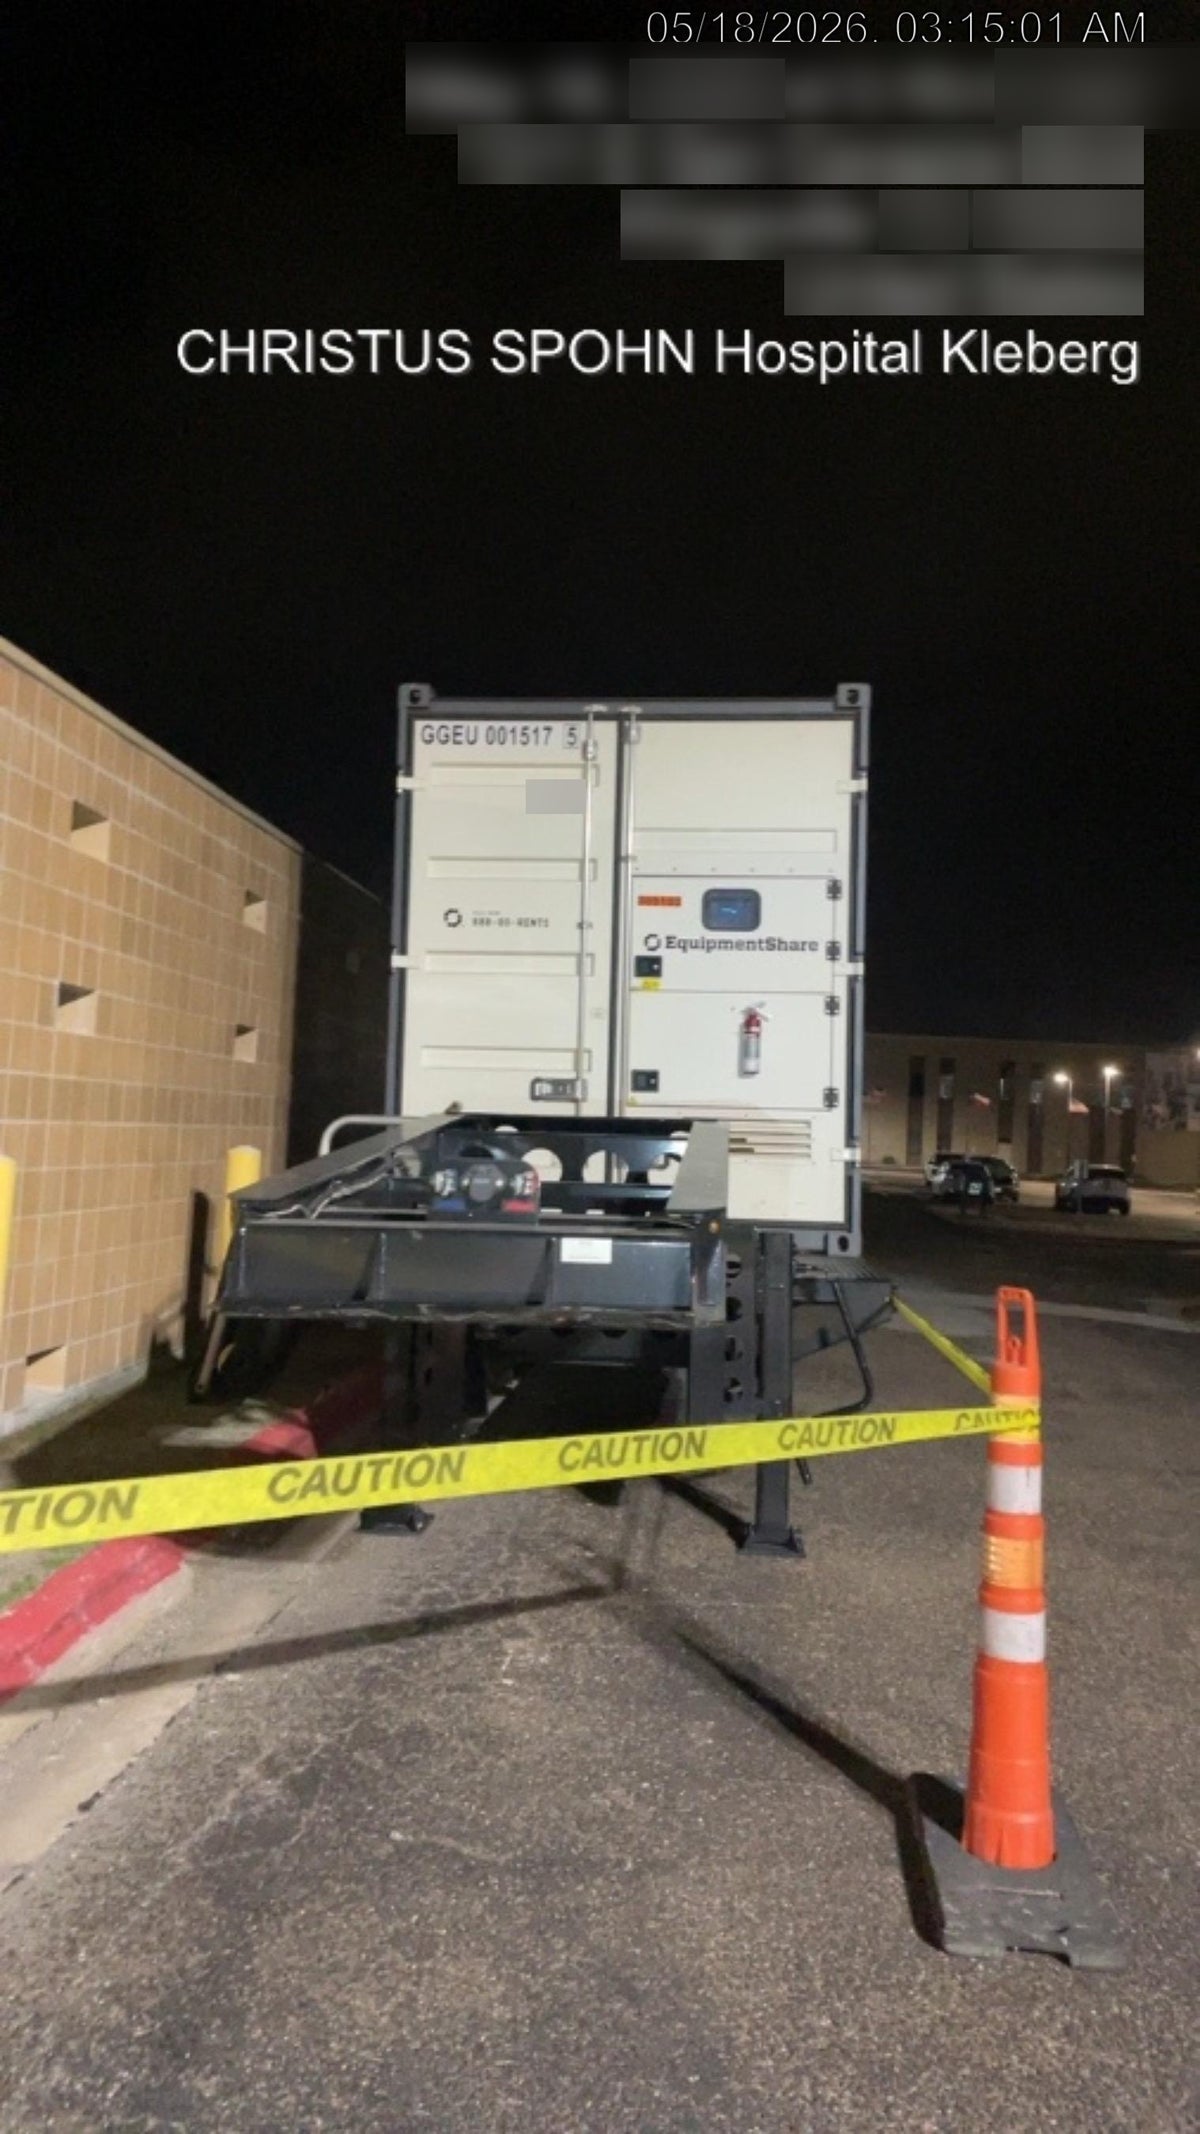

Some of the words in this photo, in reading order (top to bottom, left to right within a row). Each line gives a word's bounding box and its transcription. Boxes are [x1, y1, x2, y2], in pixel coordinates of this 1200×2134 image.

[421, 724, 478, 746] GGEU
[485, 725, 553, 747] 001517
[567, 726, 578, 747] 5
[665, 935, 819, 953] EquipmentShare
[266, 1450, 467, 1502] CAUTION
[558, 1430, 708, 1471] CAUTION
[778, 1417, 897, 1450] CAUTION
